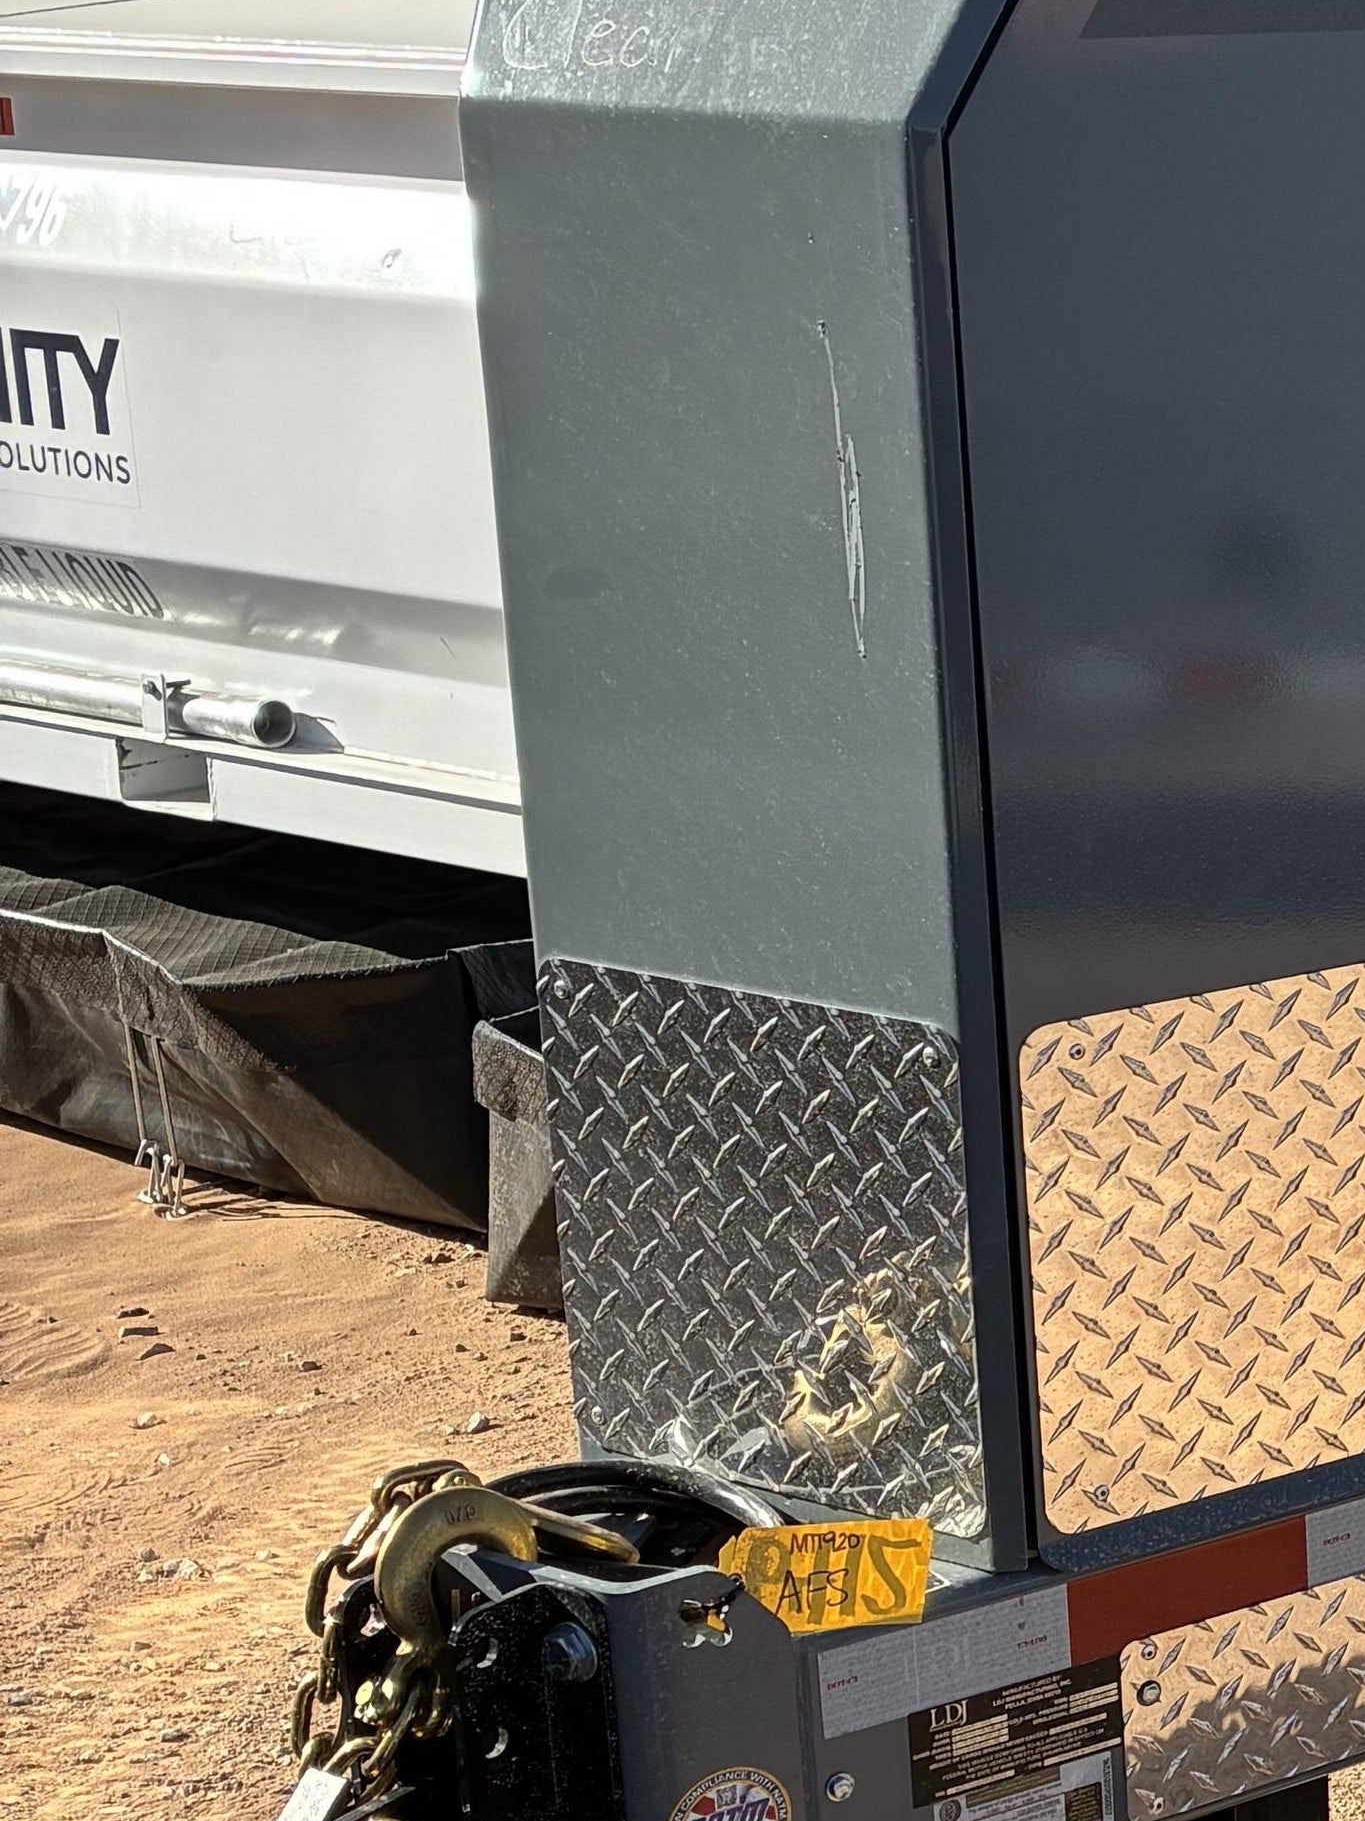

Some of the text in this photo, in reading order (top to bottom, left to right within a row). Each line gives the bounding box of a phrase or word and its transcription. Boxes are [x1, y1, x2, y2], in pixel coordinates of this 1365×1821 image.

[775, 1568, 849, 1617] AFS
[930, 1699, 967, 1729] LDJ
[682, 1771, 748, 1811] COMPLIANCE
[750, 1773, 775, 1790] WITH
